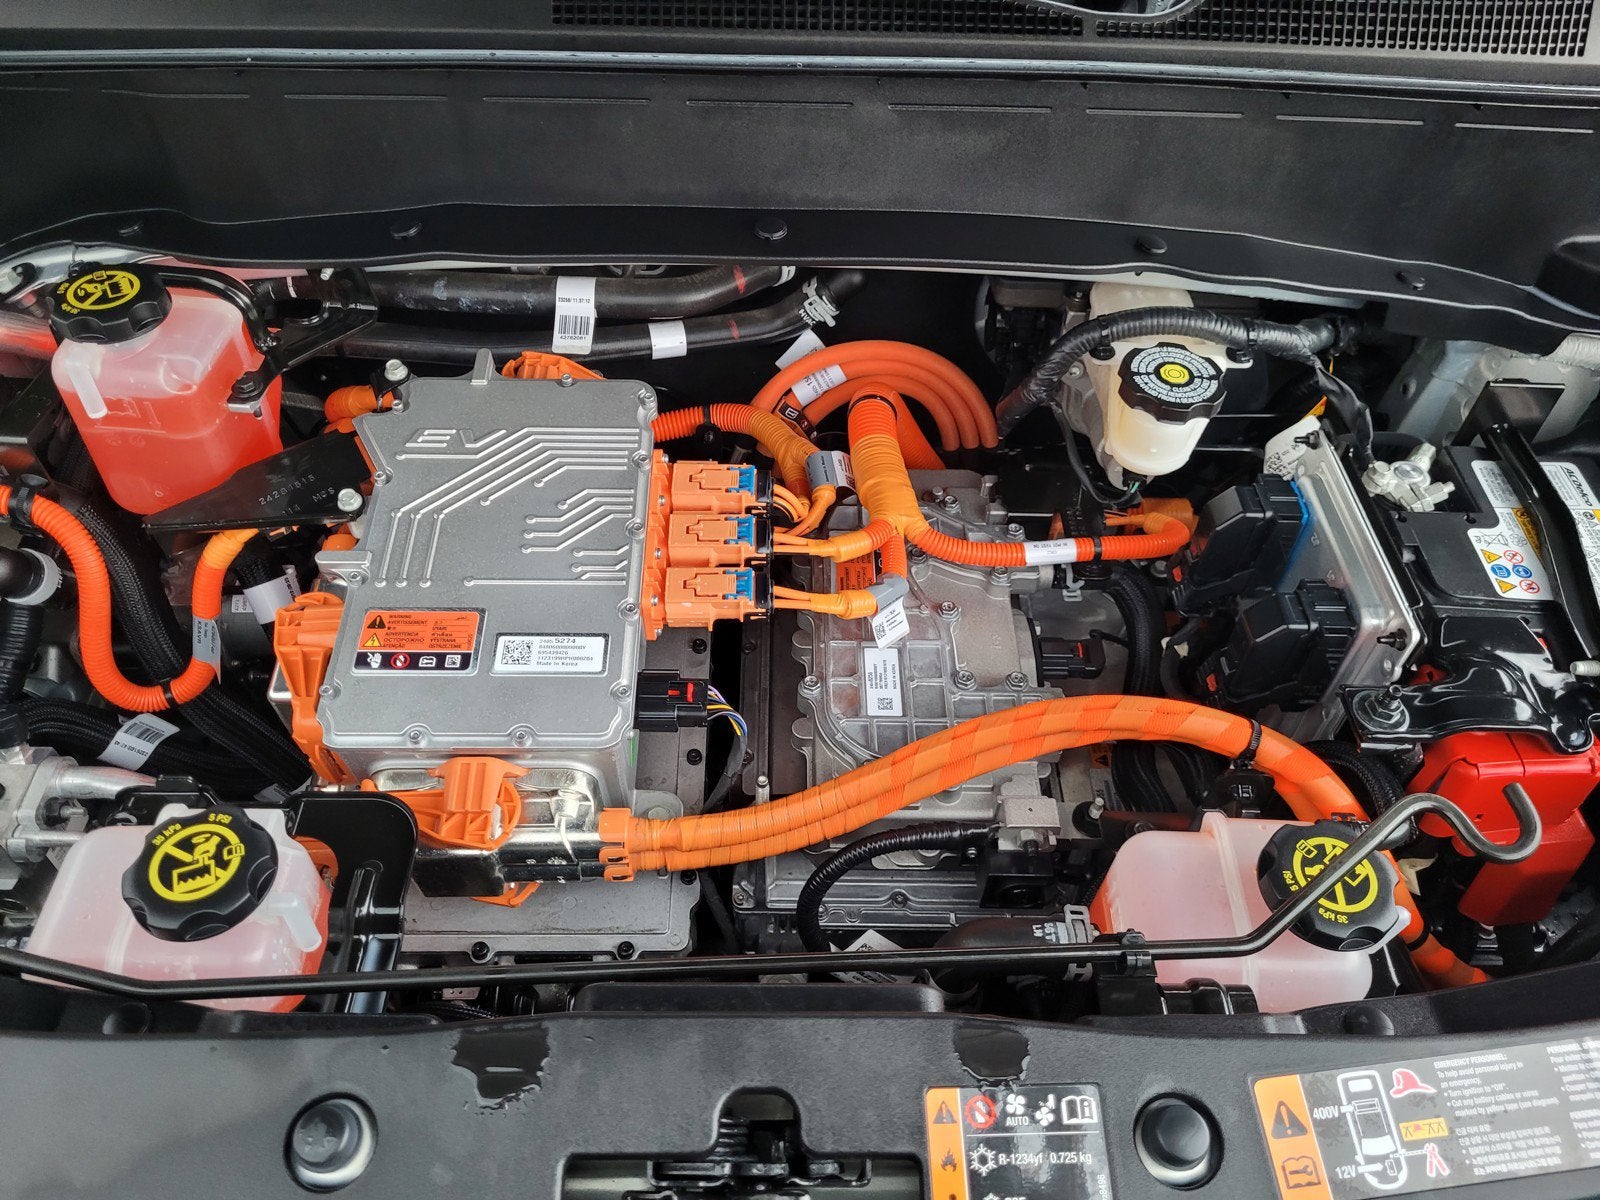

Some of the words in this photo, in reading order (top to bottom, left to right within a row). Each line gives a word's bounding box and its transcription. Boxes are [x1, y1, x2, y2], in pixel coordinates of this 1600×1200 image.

[208, 813, 217, 822] 5
[215, 814, 233, 825] PSI
[1318, 907, 1339, 922] kPa
[1337, 914, 1349, 924] 35
[1313, 1105, 1340, 1120] 400V
[1005, 1116, 1030, 1126] AUTO
[998, 1153, 1044, 1167] R-1234yf
[1049, 1152, 1078, 1164] 0.725
[1079, 1152, 1092, 1165] kg
[1335, 1165, 1357, 1179] 12V
